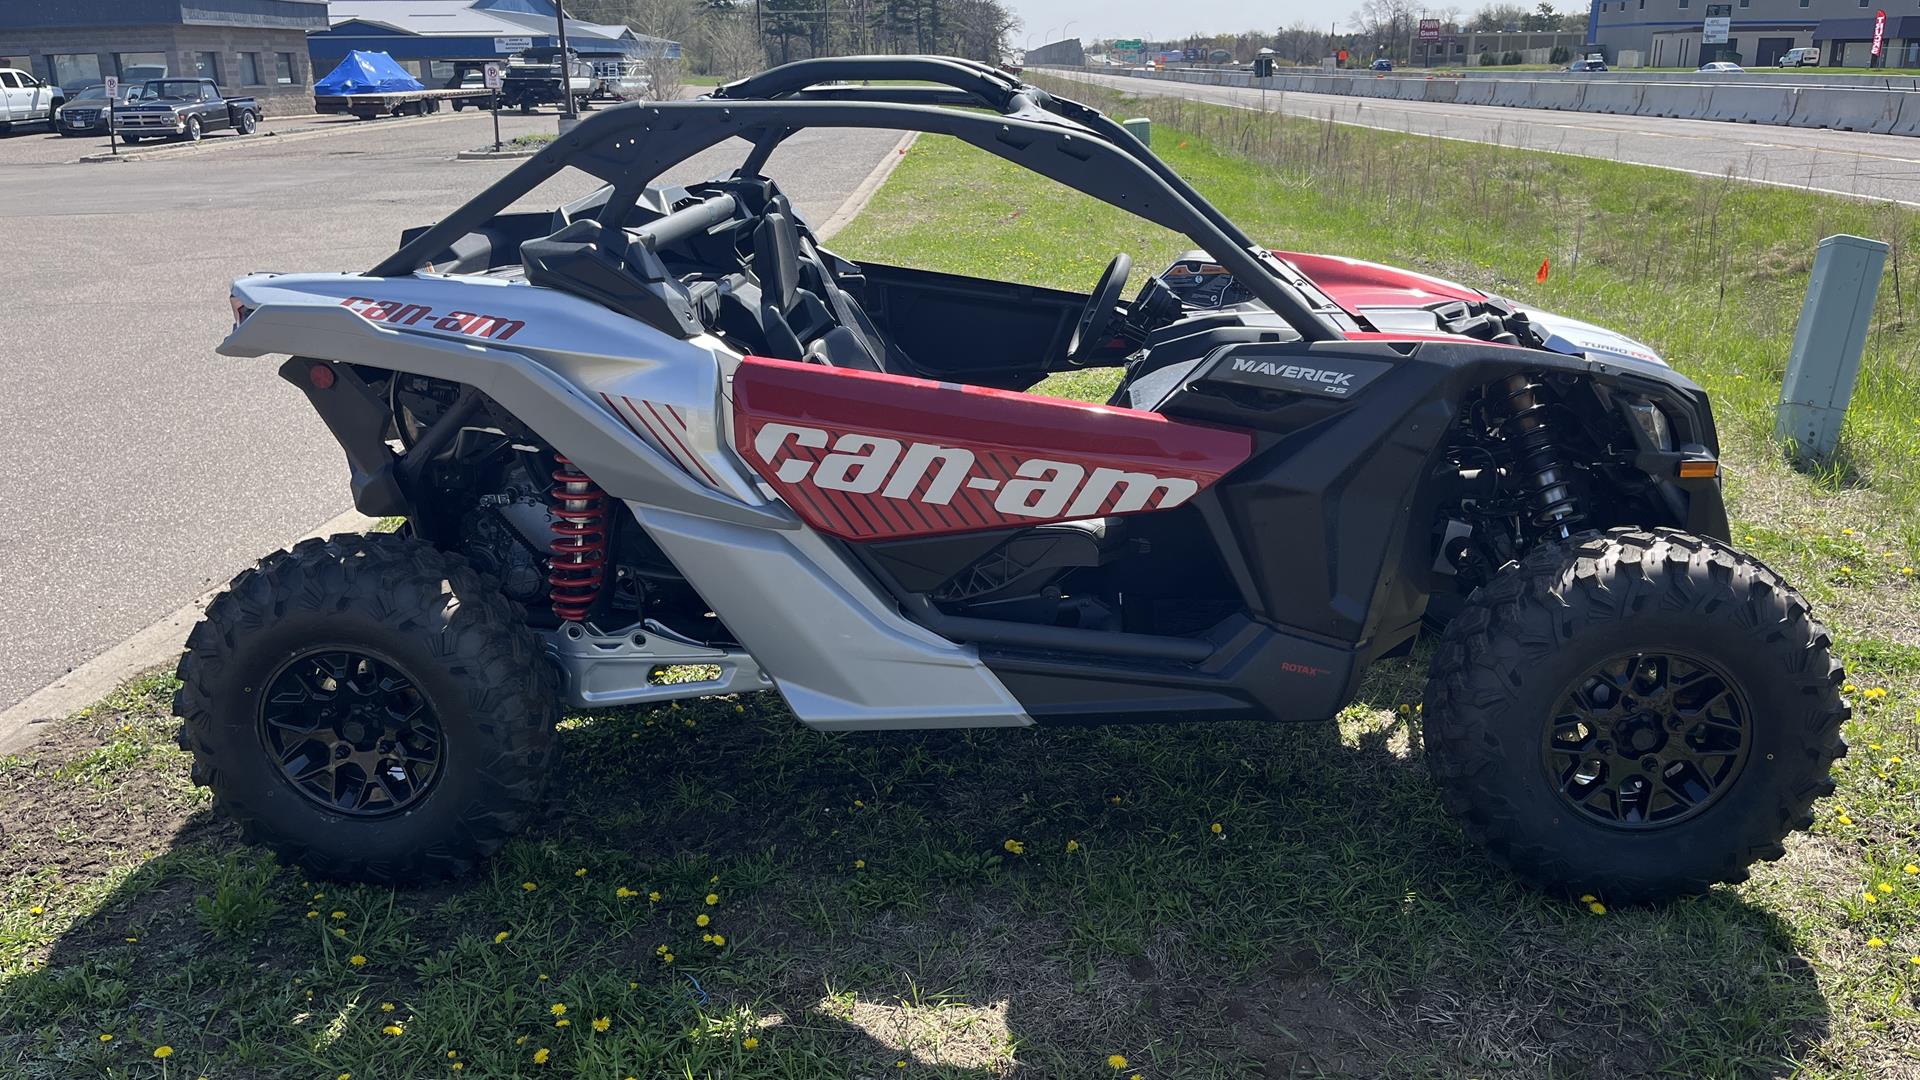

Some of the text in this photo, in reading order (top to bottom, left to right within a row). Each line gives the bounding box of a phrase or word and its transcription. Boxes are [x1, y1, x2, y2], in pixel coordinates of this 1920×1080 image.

[1421, 20, 1440, 29] PAWN
[340, 296, 526, 341] can-am
[1582, 341, 1628, 355] TURBO
[1232, 358, 1355, 386] MAVERICK
[1324, 386, 1348, 394] DS
[755, 422, 1199, 518] can-am
[1281, 662, 1318, 677] ROTAX
